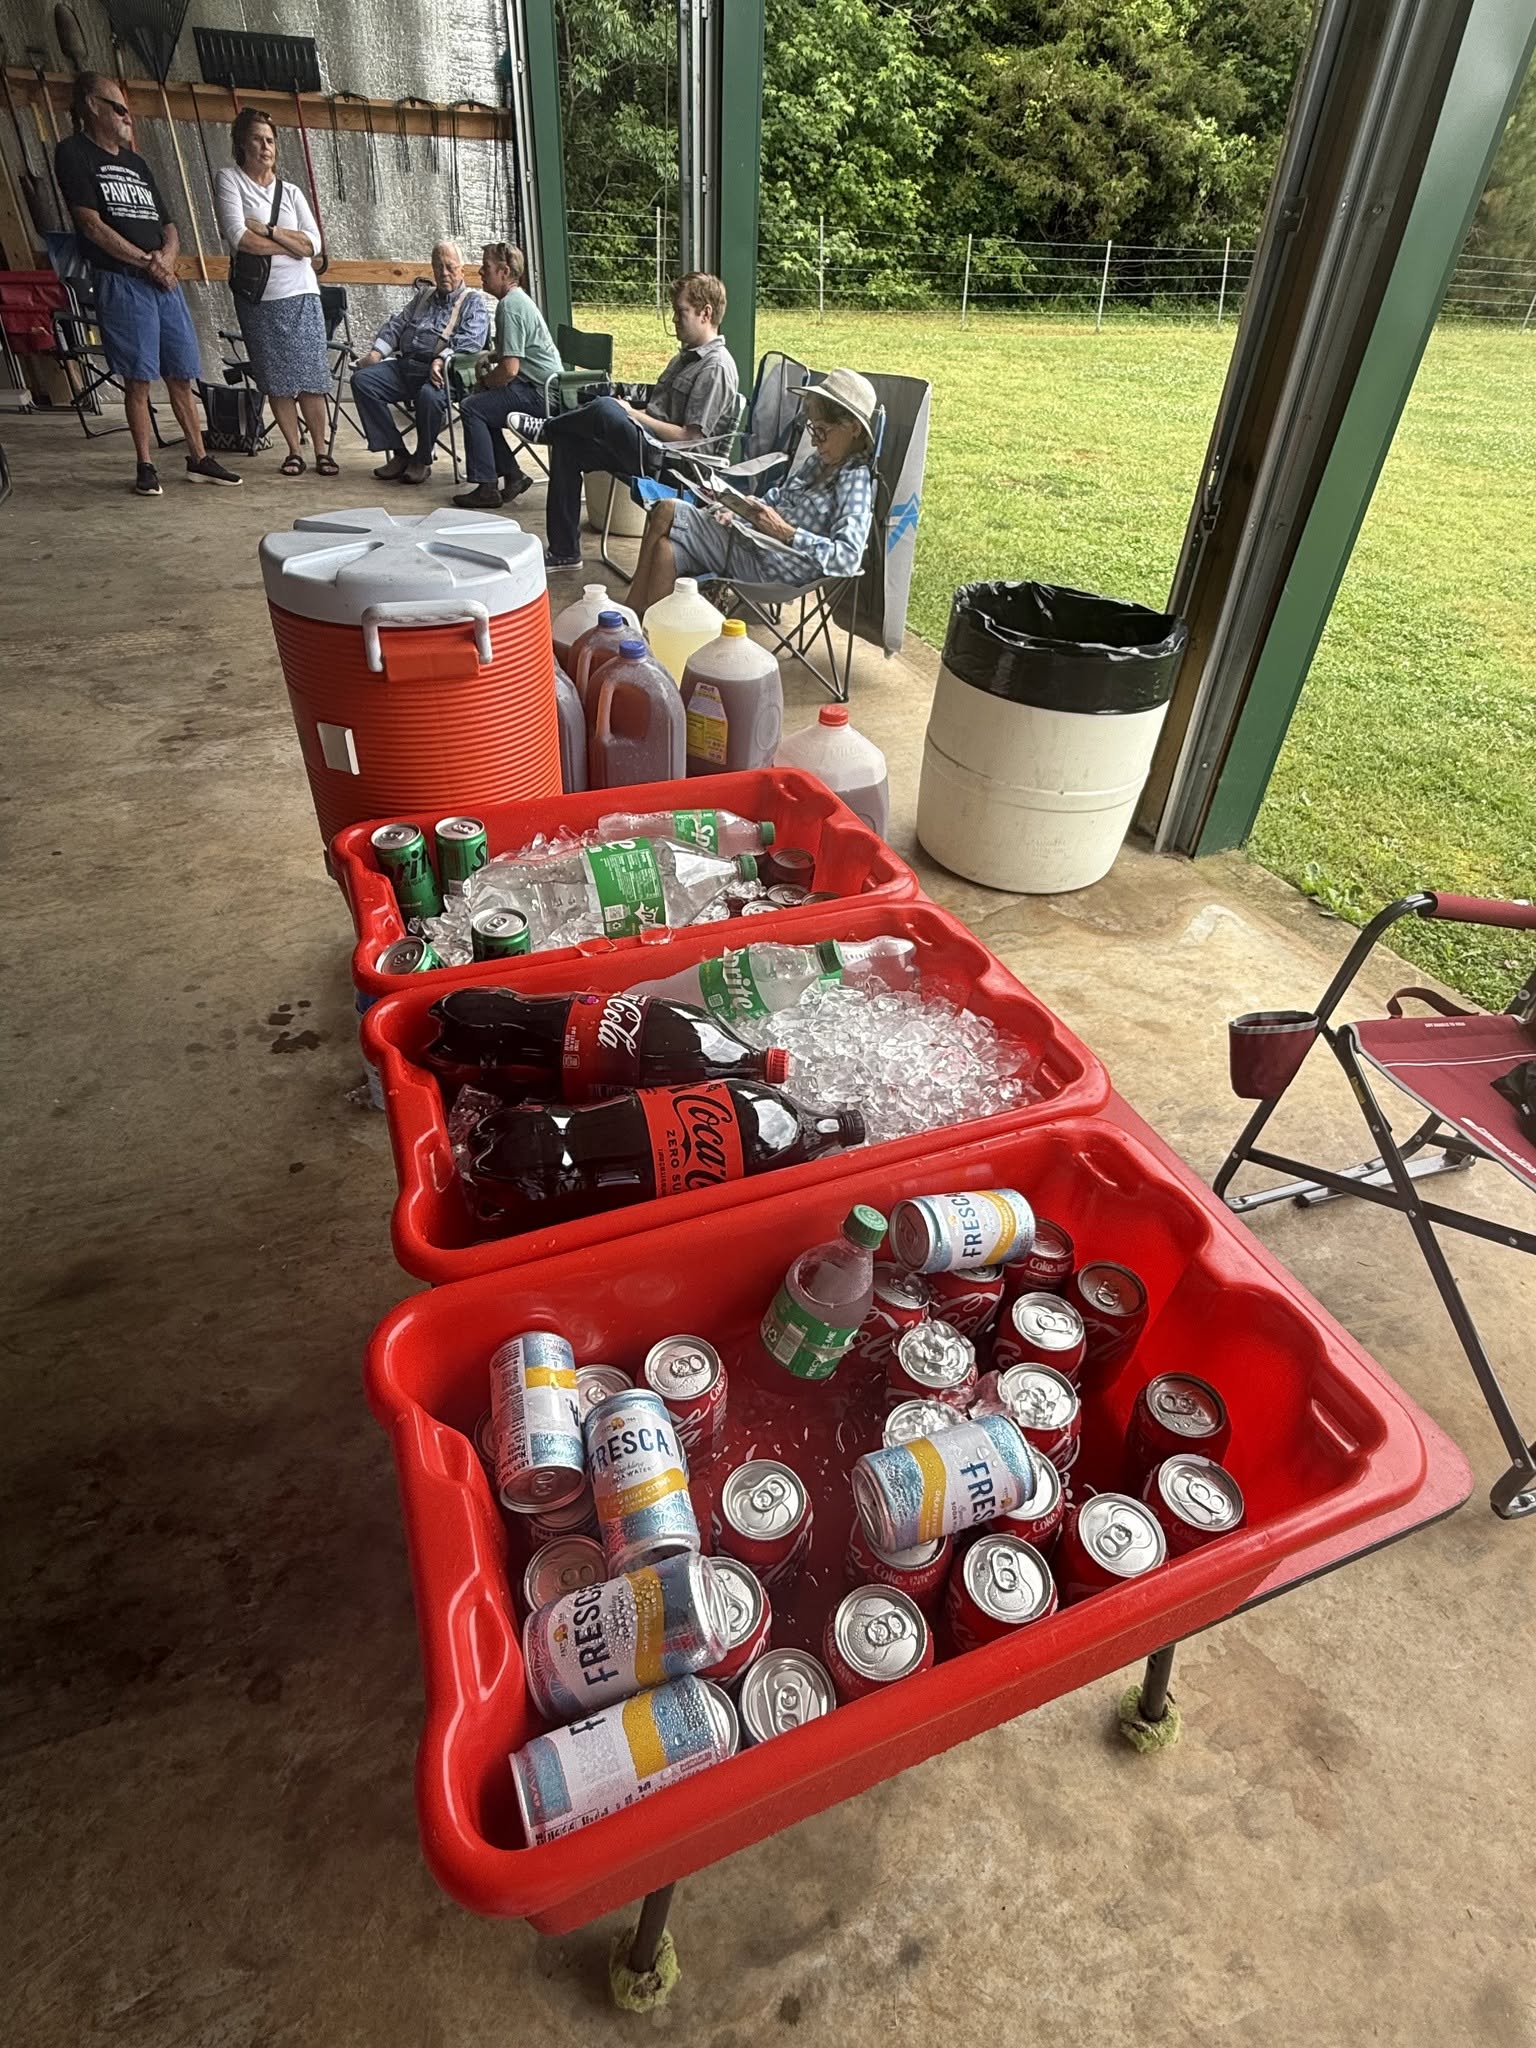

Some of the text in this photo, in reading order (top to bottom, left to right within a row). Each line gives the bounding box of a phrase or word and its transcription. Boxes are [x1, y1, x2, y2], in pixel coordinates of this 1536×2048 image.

[100, 182, 156, 208] PAWPAW
[666, 1130, 680, 1167] ZERO
[1029, 1257, 1054, 1273] Coke
[827, 1331, 837, 1345] ME
[710, 1376, 725, 1401] Coke
[588, 1428, 672, 1485] FRESCA
[873, 1562, 904, 1585] Coke
